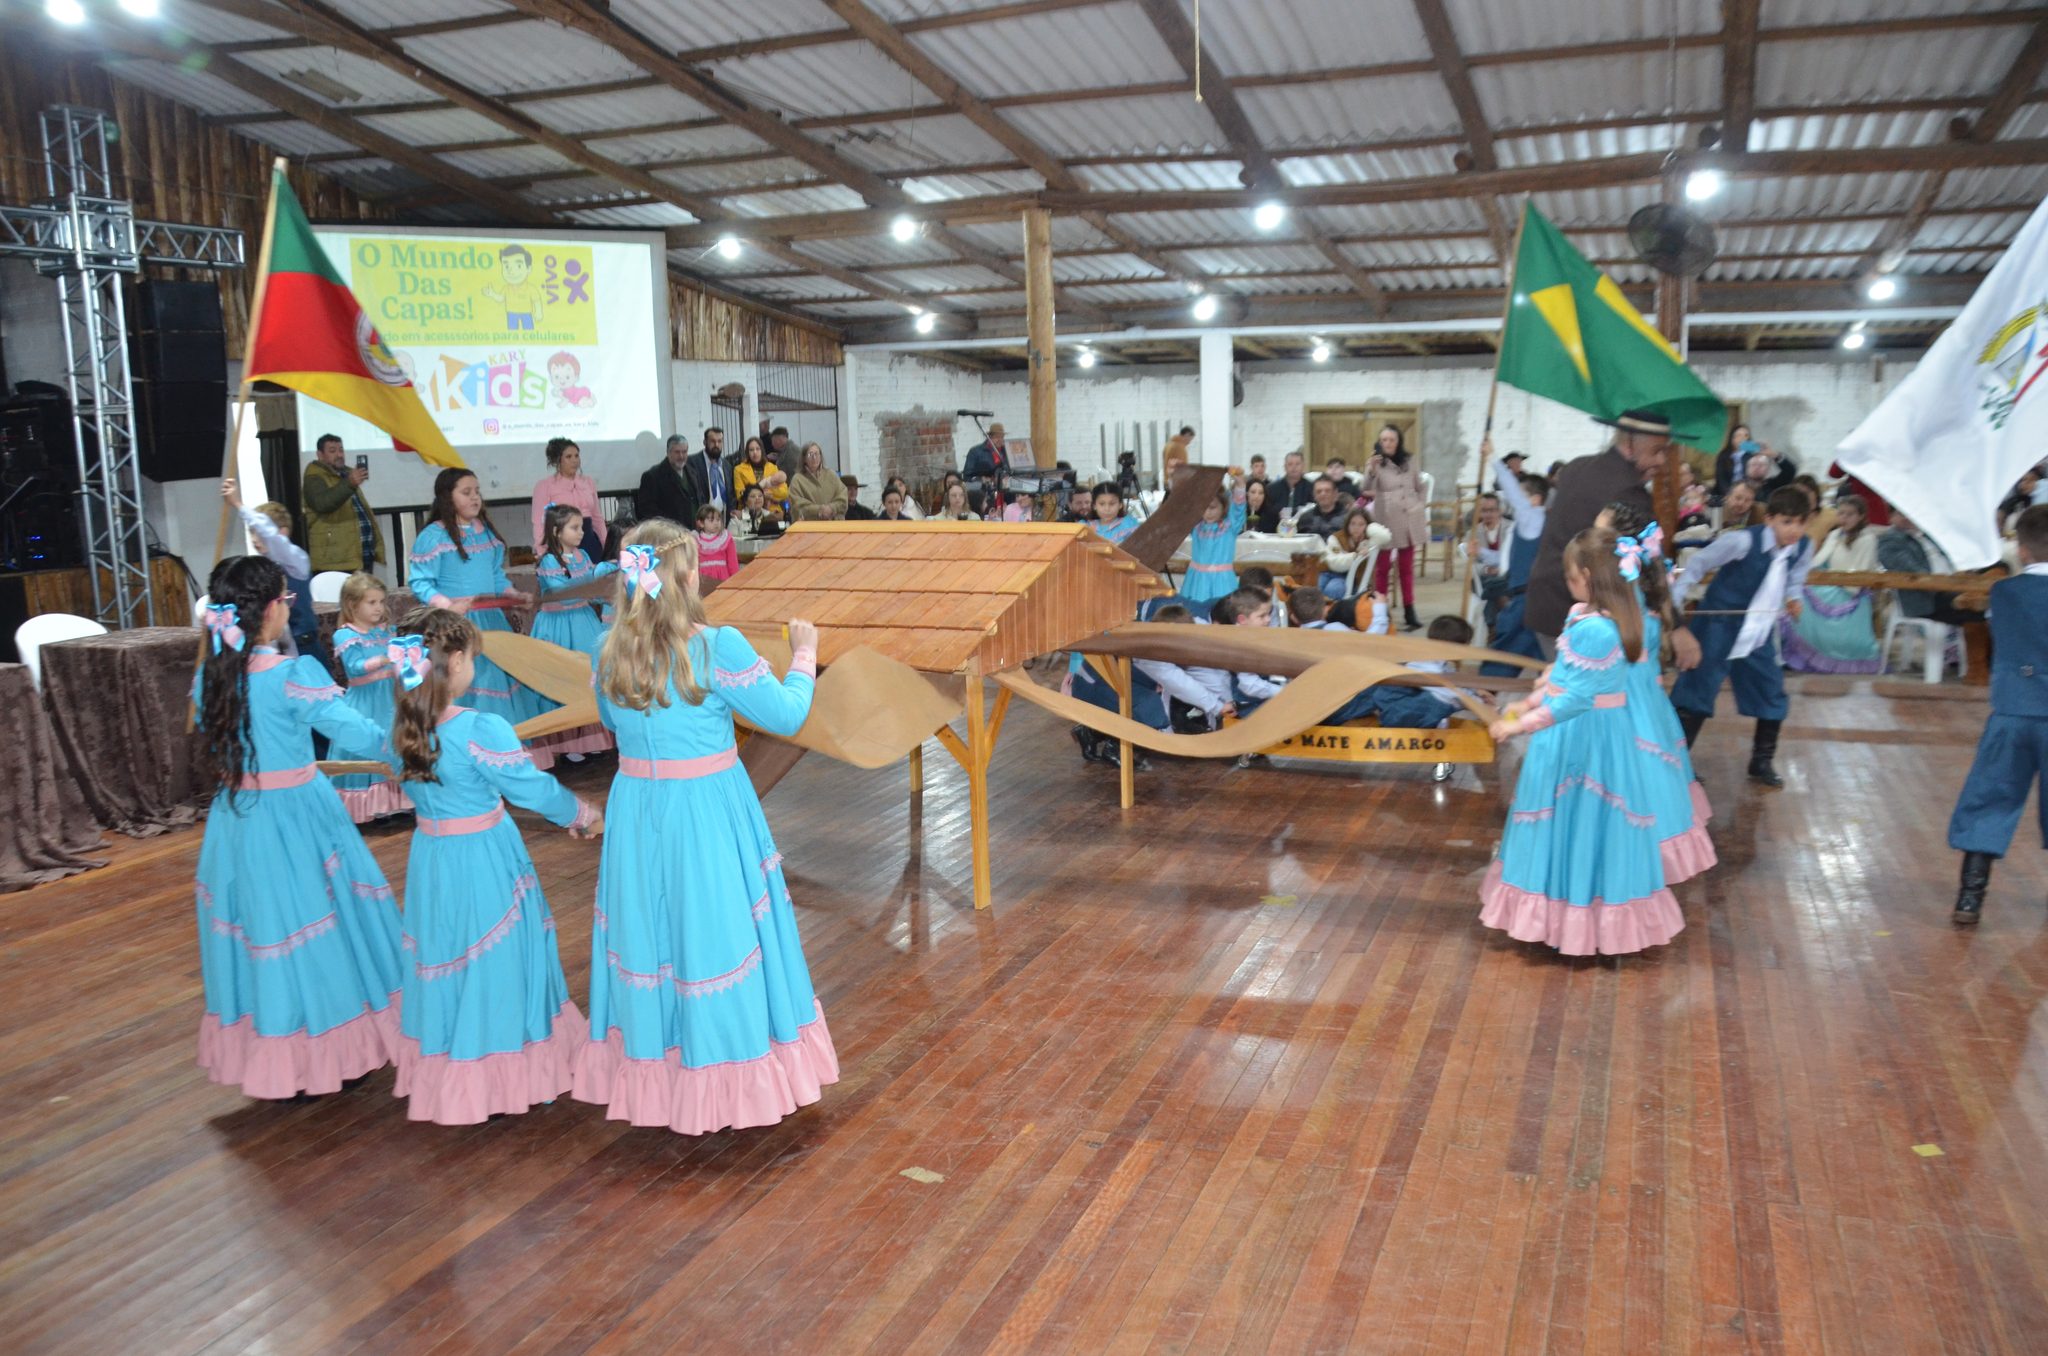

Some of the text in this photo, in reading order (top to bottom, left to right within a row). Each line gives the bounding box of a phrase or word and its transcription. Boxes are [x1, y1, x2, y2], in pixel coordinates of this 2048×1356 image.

[358, 243, 493, 270] O Mundo
[398, 272, 452, 295] Das
[541, 254, 559, 304] vivo
[381, 297, 474, 326] Capas!
[401, 332, 421, 341] em
[493, 332, 520, 344] para
[522, 331, 576, 342] celulares
[488, 350, 526, 366] KARY
[1301, 735, 1349, 749] MATE
[1364, 738, 1446, 750] AMARGO
